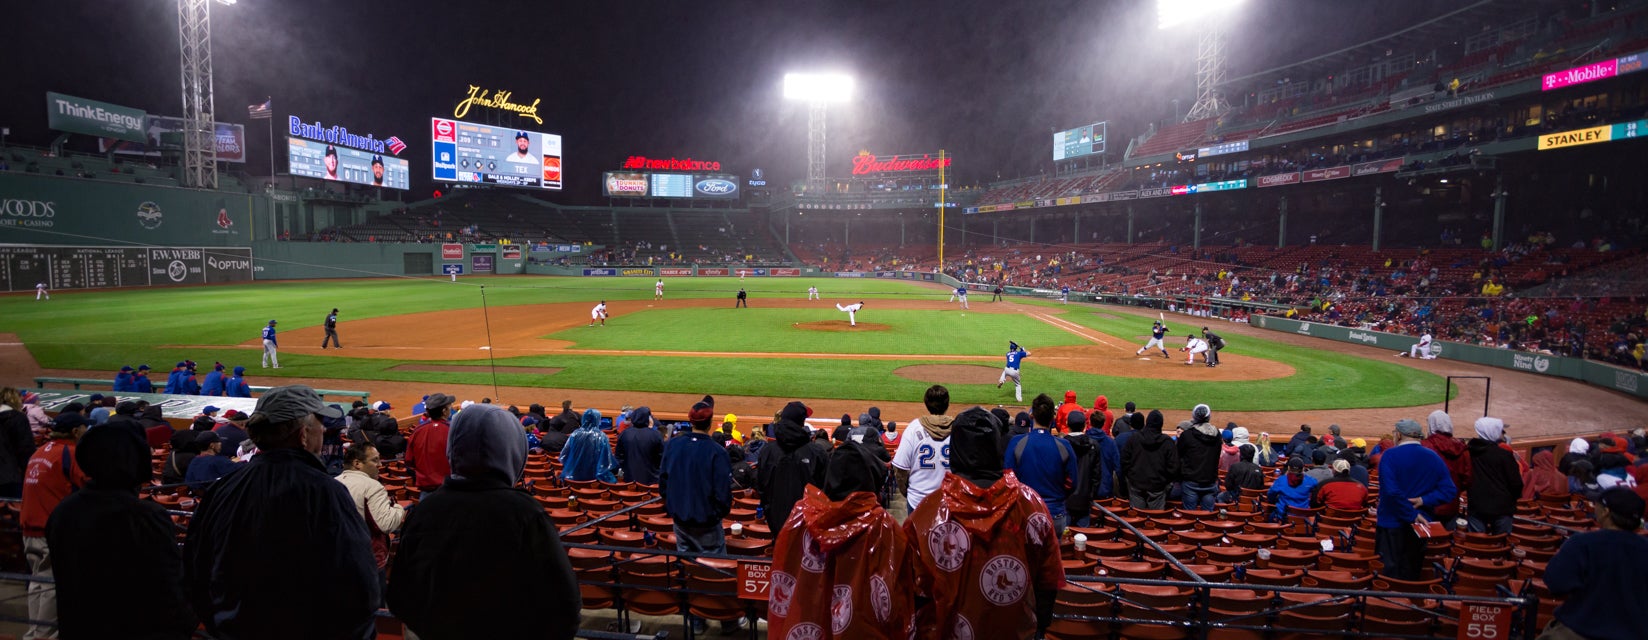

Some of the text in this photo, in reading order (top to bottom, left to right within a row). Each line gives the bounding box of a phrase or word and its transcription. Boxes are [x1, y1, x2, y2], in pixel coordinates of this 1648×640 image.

[454, 84, 543, 125] John Hancock
[289, 115, 385, 153] Bank of America
[1546, 129, 1602, 147] STANLEY
[646, 158, 671, 170] new
[671, 158, 721, 171] balance
[703, 181, 728, 193] Ford
[24, 220, 54, 228] CASINO
[172, 249, 201, 260] WEBB
[218, 260, 250, 270] OPTUM
[1009, 354, 1014, 362] 5
[1514, 354, 1534, 363] Ninety
[1514, 360, 1532, 370] Nine
[920, 444, 950, 470] 29
[933, 523, 960, 544] BOSTON
[744, 564, 770, 572] FIELD
[986, 559, 1021, 577] BOSTON
[748, 571, 767, 579] BOX
[744, 580, 770, 594] 57
[987, 586, 1024, 602] RED SOX
[1469, 605, 1502, 614] FIELD
[1472, 614, 1495, 622] BOX
[792, 624, 823, 639] BOSTO
[1466, 623, 1498, 639] 55
